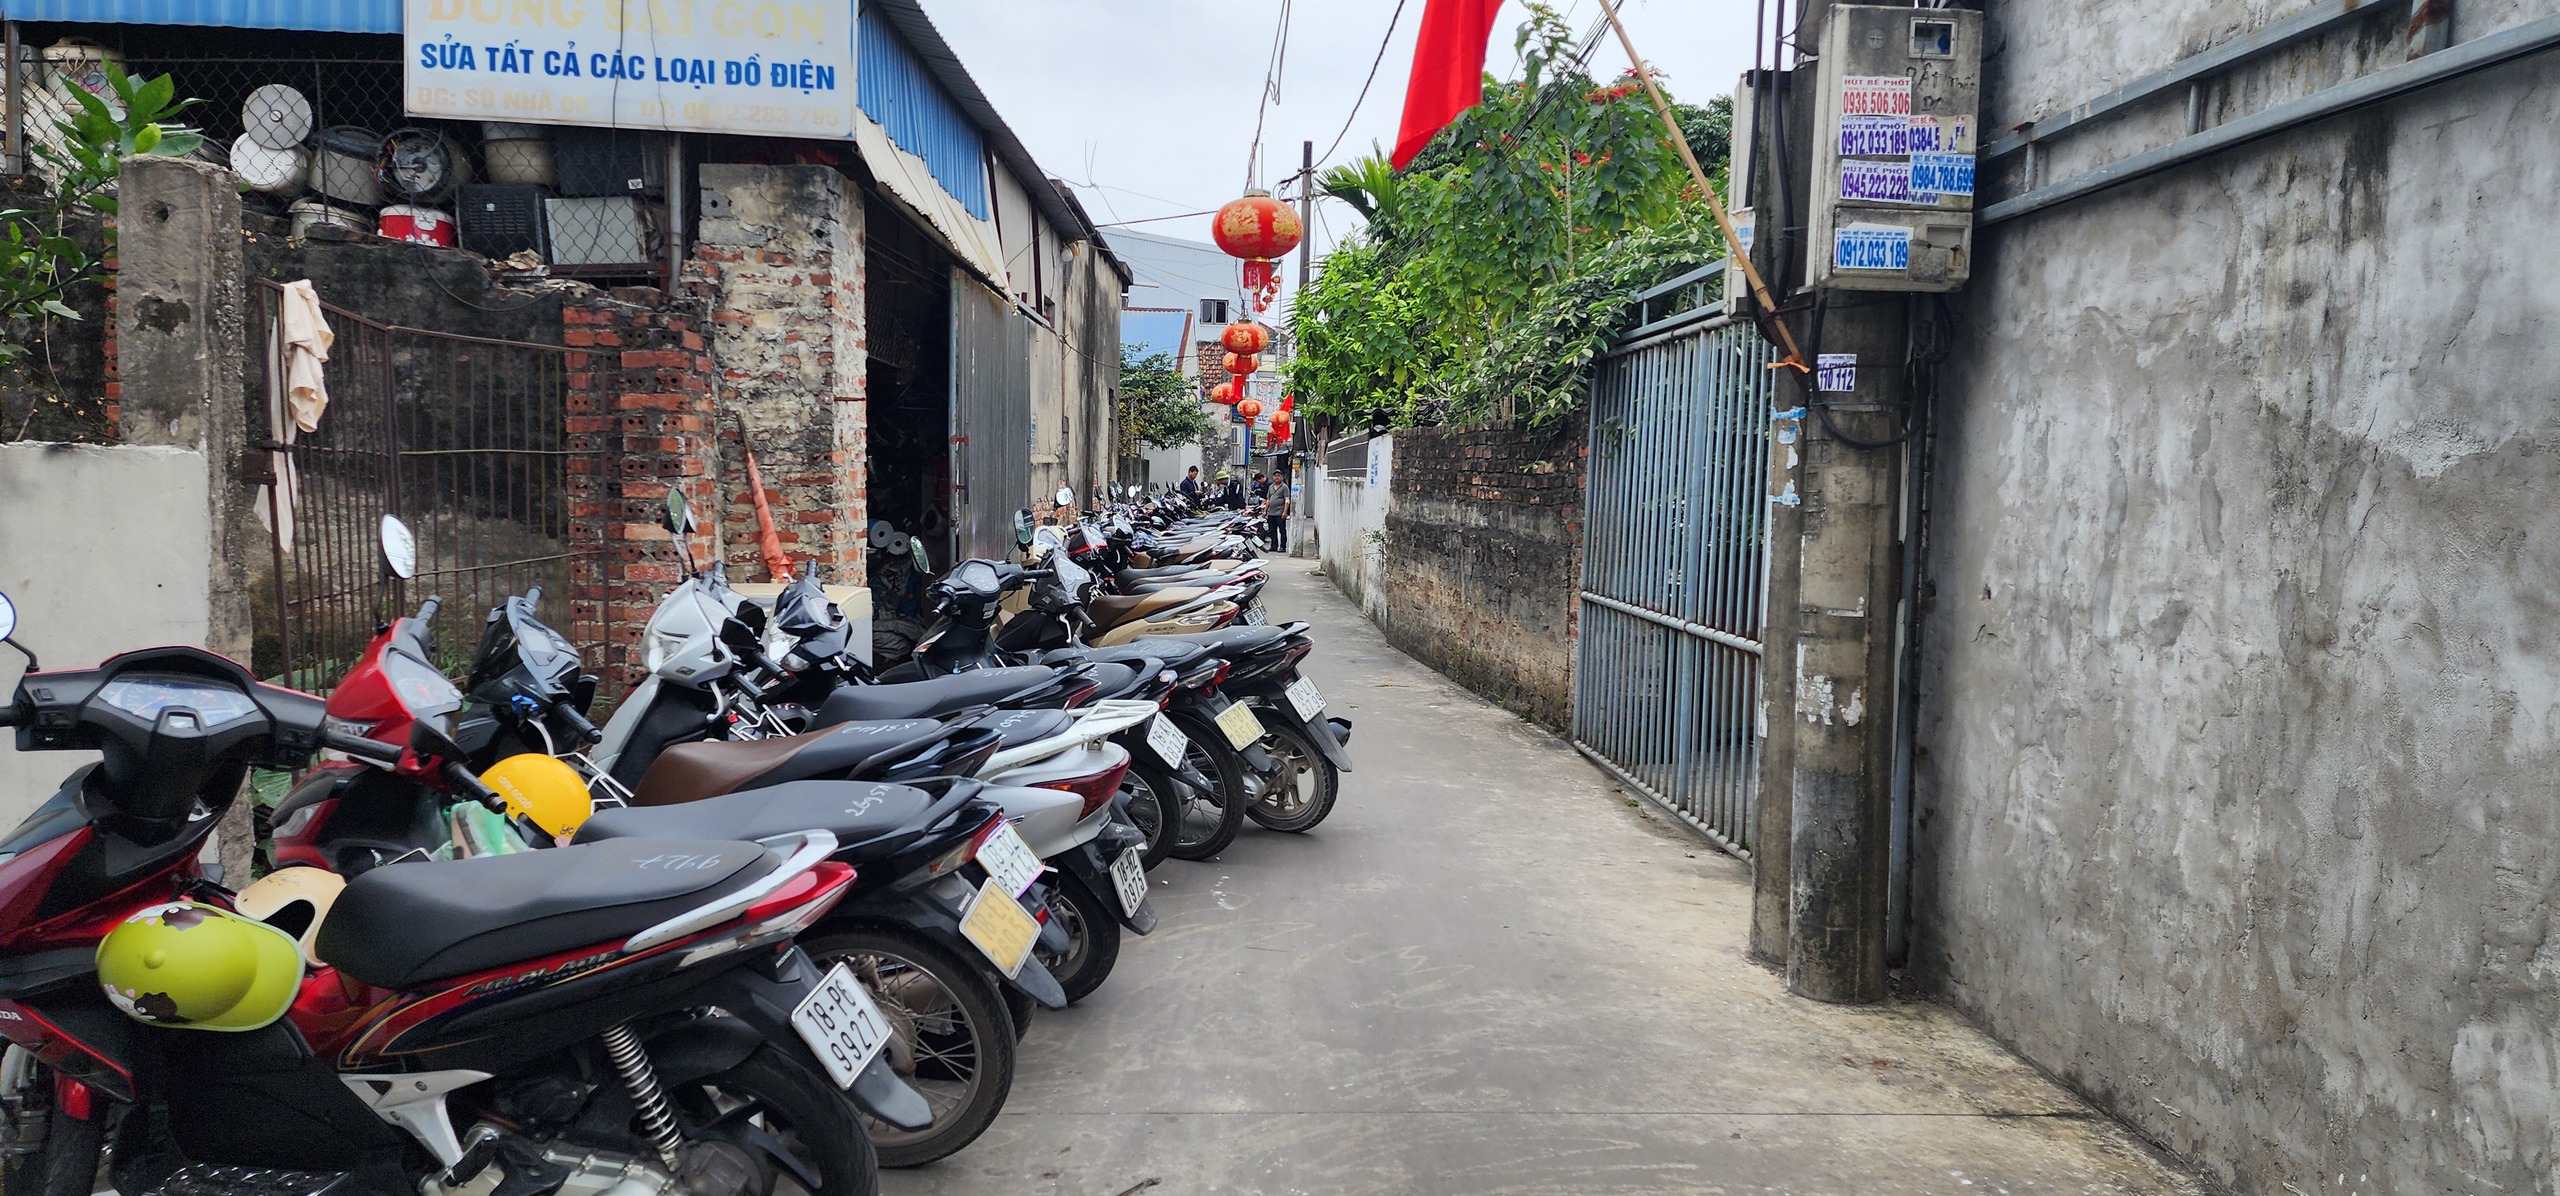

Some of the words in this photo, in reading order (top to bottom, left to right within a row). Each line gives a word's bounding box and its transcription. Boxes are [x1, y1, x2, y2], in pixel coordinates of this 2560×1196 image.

[420, 33, 476, 71] SỬA
[485, 39, 534, 74] TẤT
[544, 41, 581, 77] CẢ
[590, 49, 645, 81] CÁC
[655, 57, 715, 89] LOẠI
[724, 53, 761, 86] ĐỒ
[770, 59, 835, 94] ĐIỆN
[1843, 91, 1910, 115] 0936.506.306
[1841, 130, 1907, 155] 0912.033.189
[1841, 172, 1909, 200] 0945.223.228
[1912, 164, 1975, 192] 0984.788.699
[1840, 239, 1908, 267] 0912.033.189
[510, 788, 533, 810] GOOD
[1124, 871, 1145, 910] 0975
[806, 978, 856, 1038] 18-P6
[830, 1008, 878, 1072] 9927
